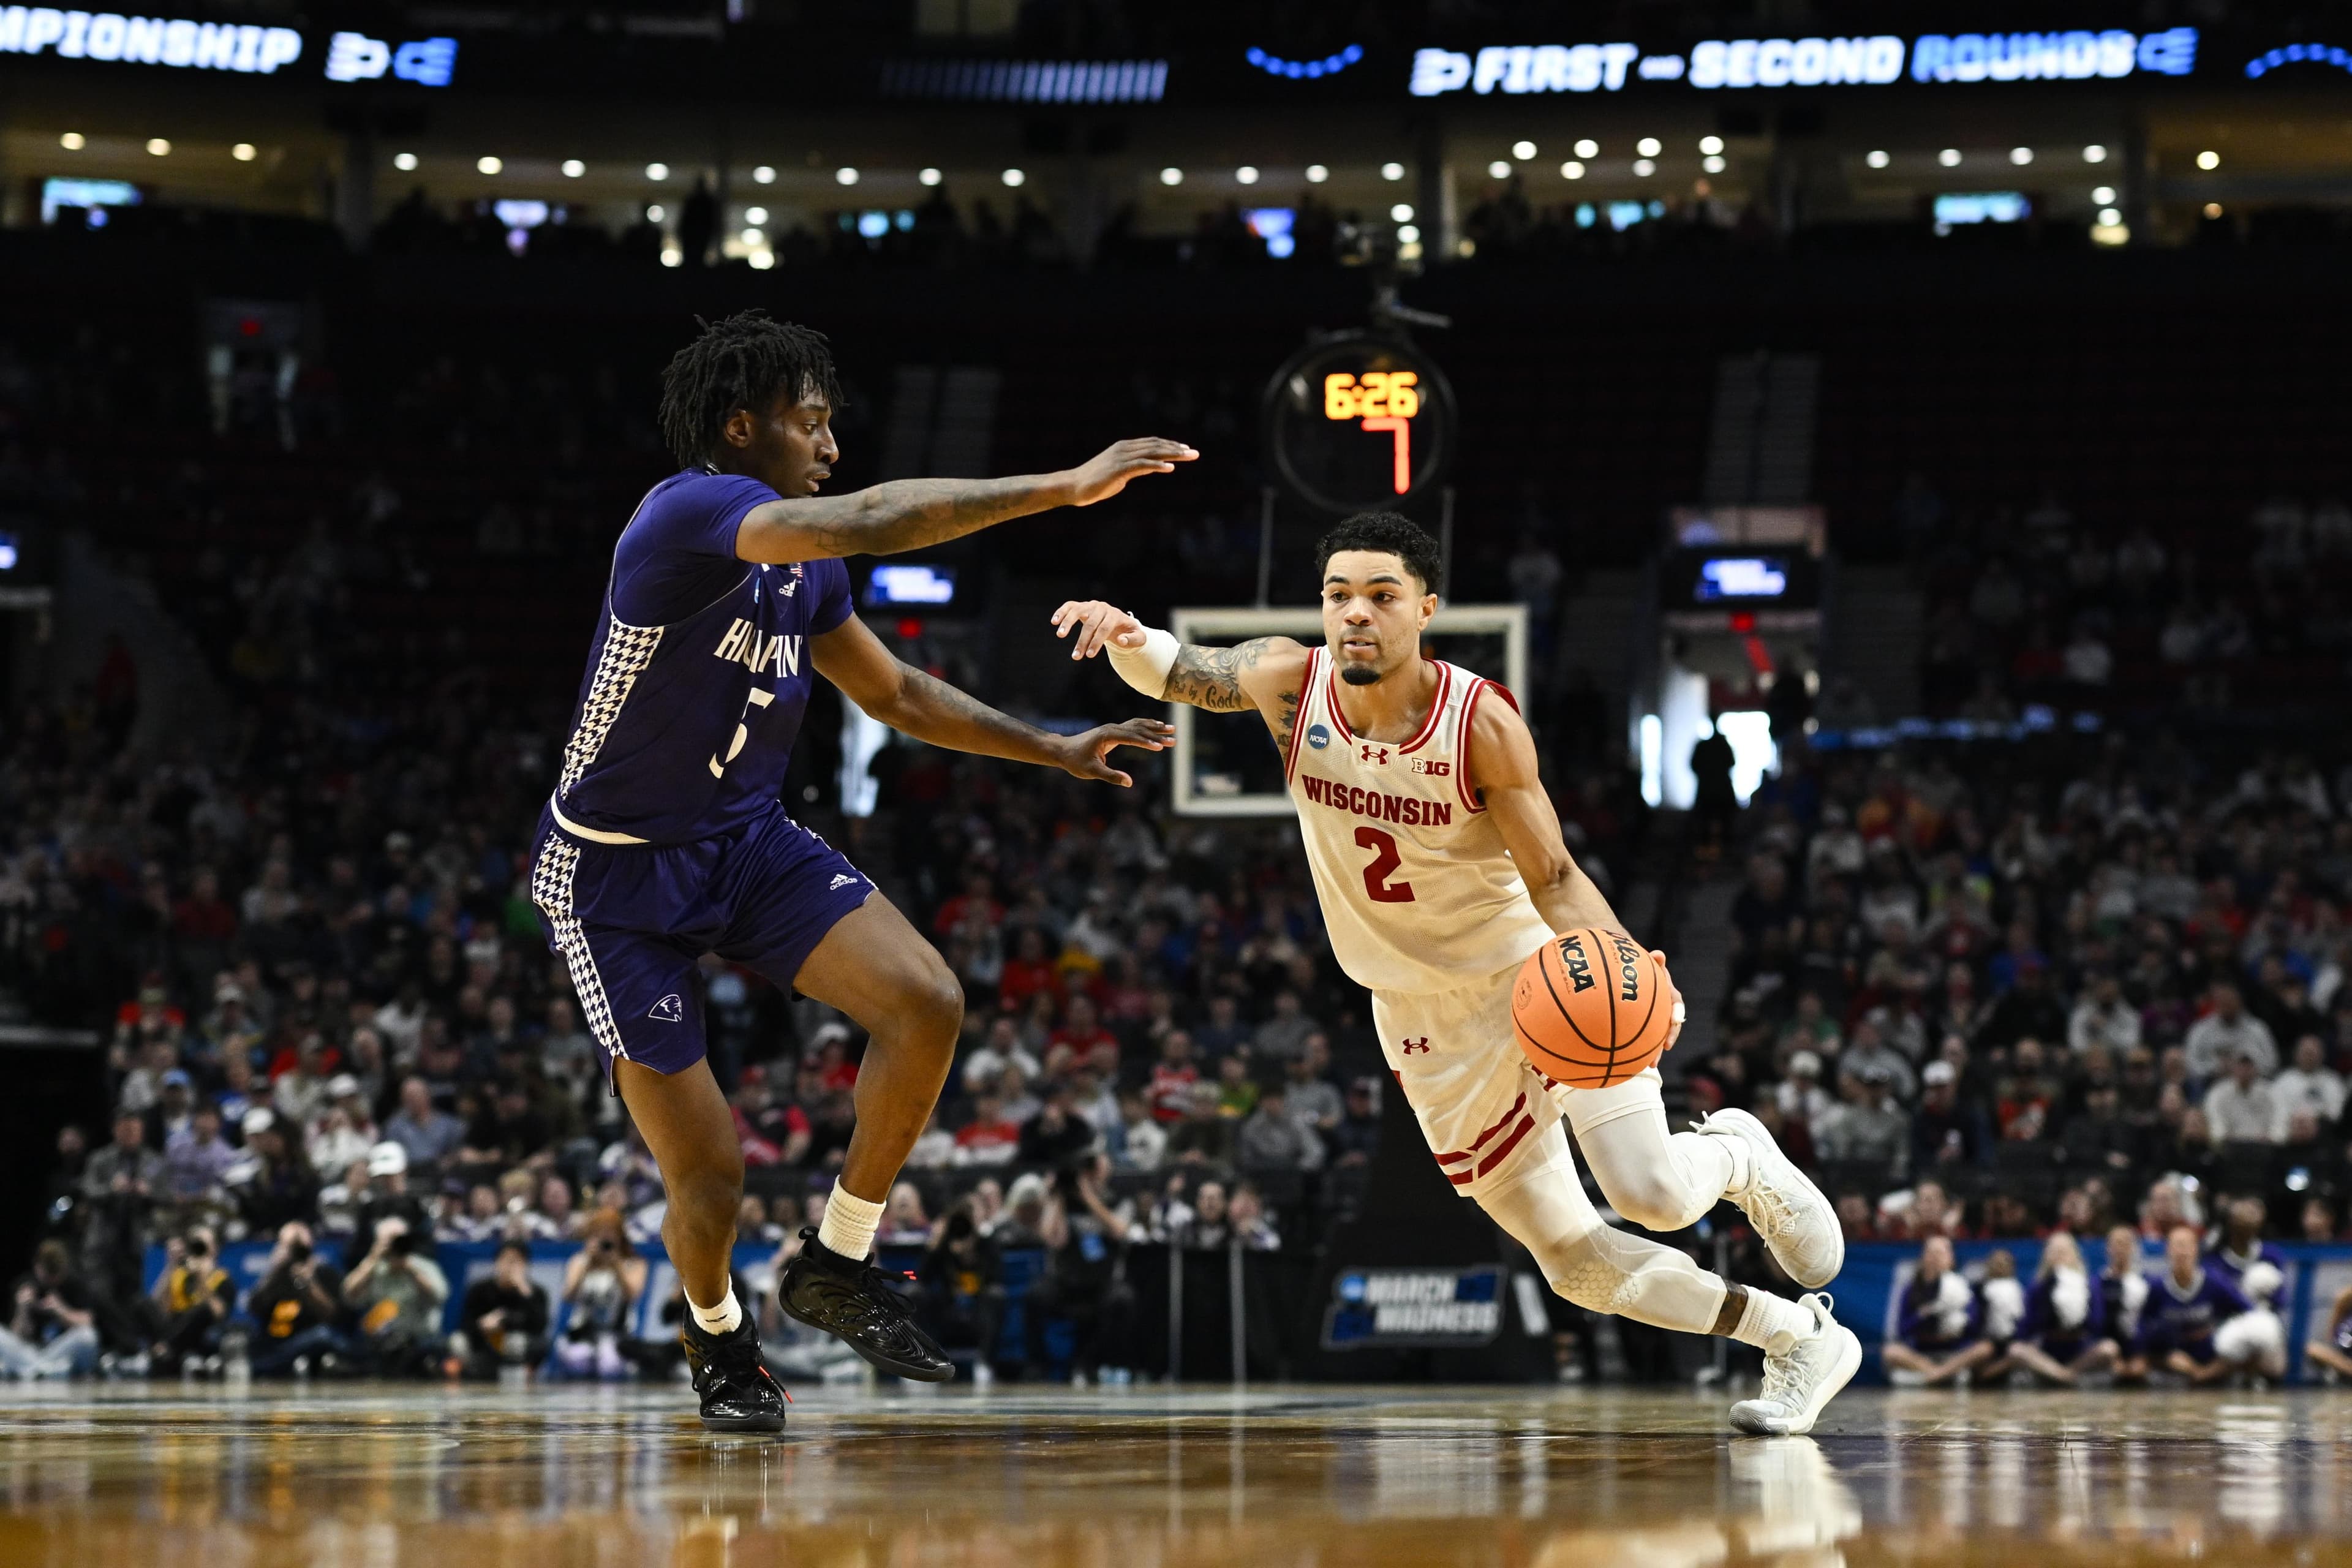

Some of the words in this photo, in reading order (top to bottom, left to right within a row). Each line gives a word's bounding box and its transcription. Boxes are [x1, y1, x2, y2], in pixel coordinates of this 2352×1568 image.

[1472, 43, 1639, 94] FIRST
[1688, 36, 1905, 88] SECOND
[1910, 29, 2138, 82] ROUNDS
[1325, 371, 1419, 420] 6:26
[1361, 417, 1409, 494] 7
[1205, 685, 1236, 709] God
[1309, 734, 1327, 745] NCAA
[1302, 774, 1452, 826] WISCONSIN
[1354, 826, 1415, 903] 2
[1557, 935, 1596, 994] NCAA
